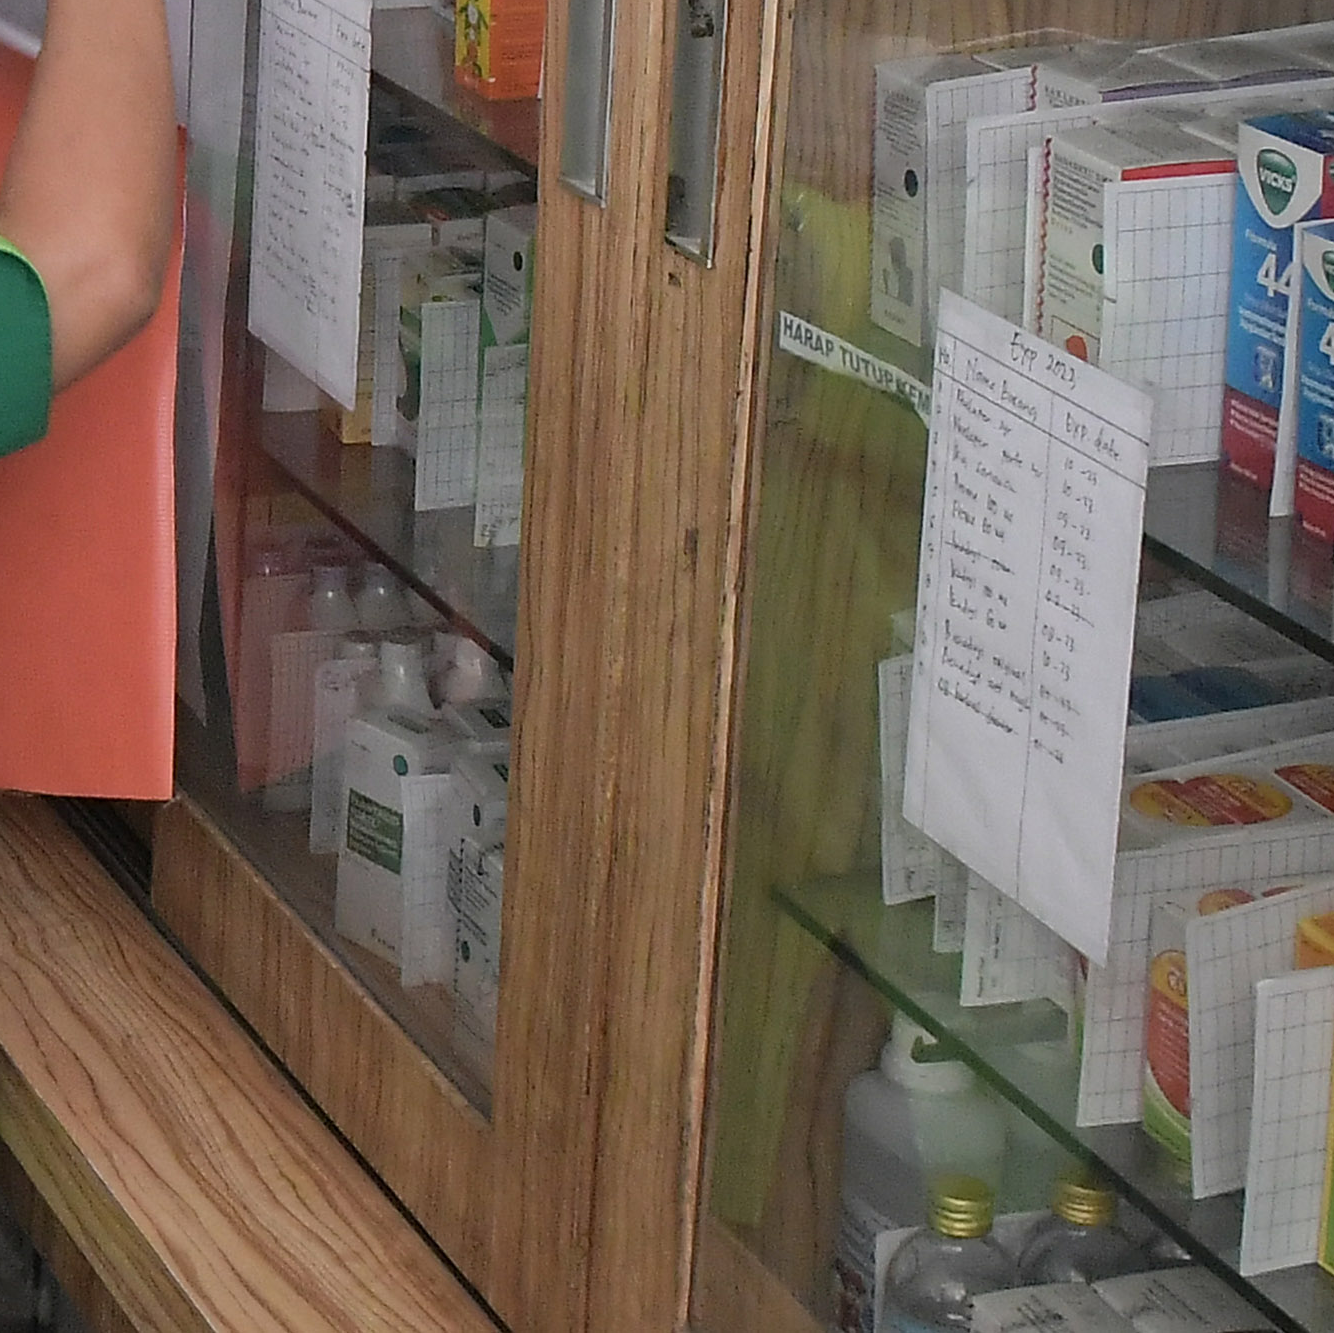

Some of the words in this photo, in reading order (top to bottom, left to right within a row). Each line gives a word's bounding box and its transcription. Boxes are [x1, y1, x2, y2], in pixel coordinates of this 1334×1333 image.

[1259, 166, 1294, 193] VICKS
[783, 316, 834, 358] HARAP
[840, 345, 893, 386] TUTUP
